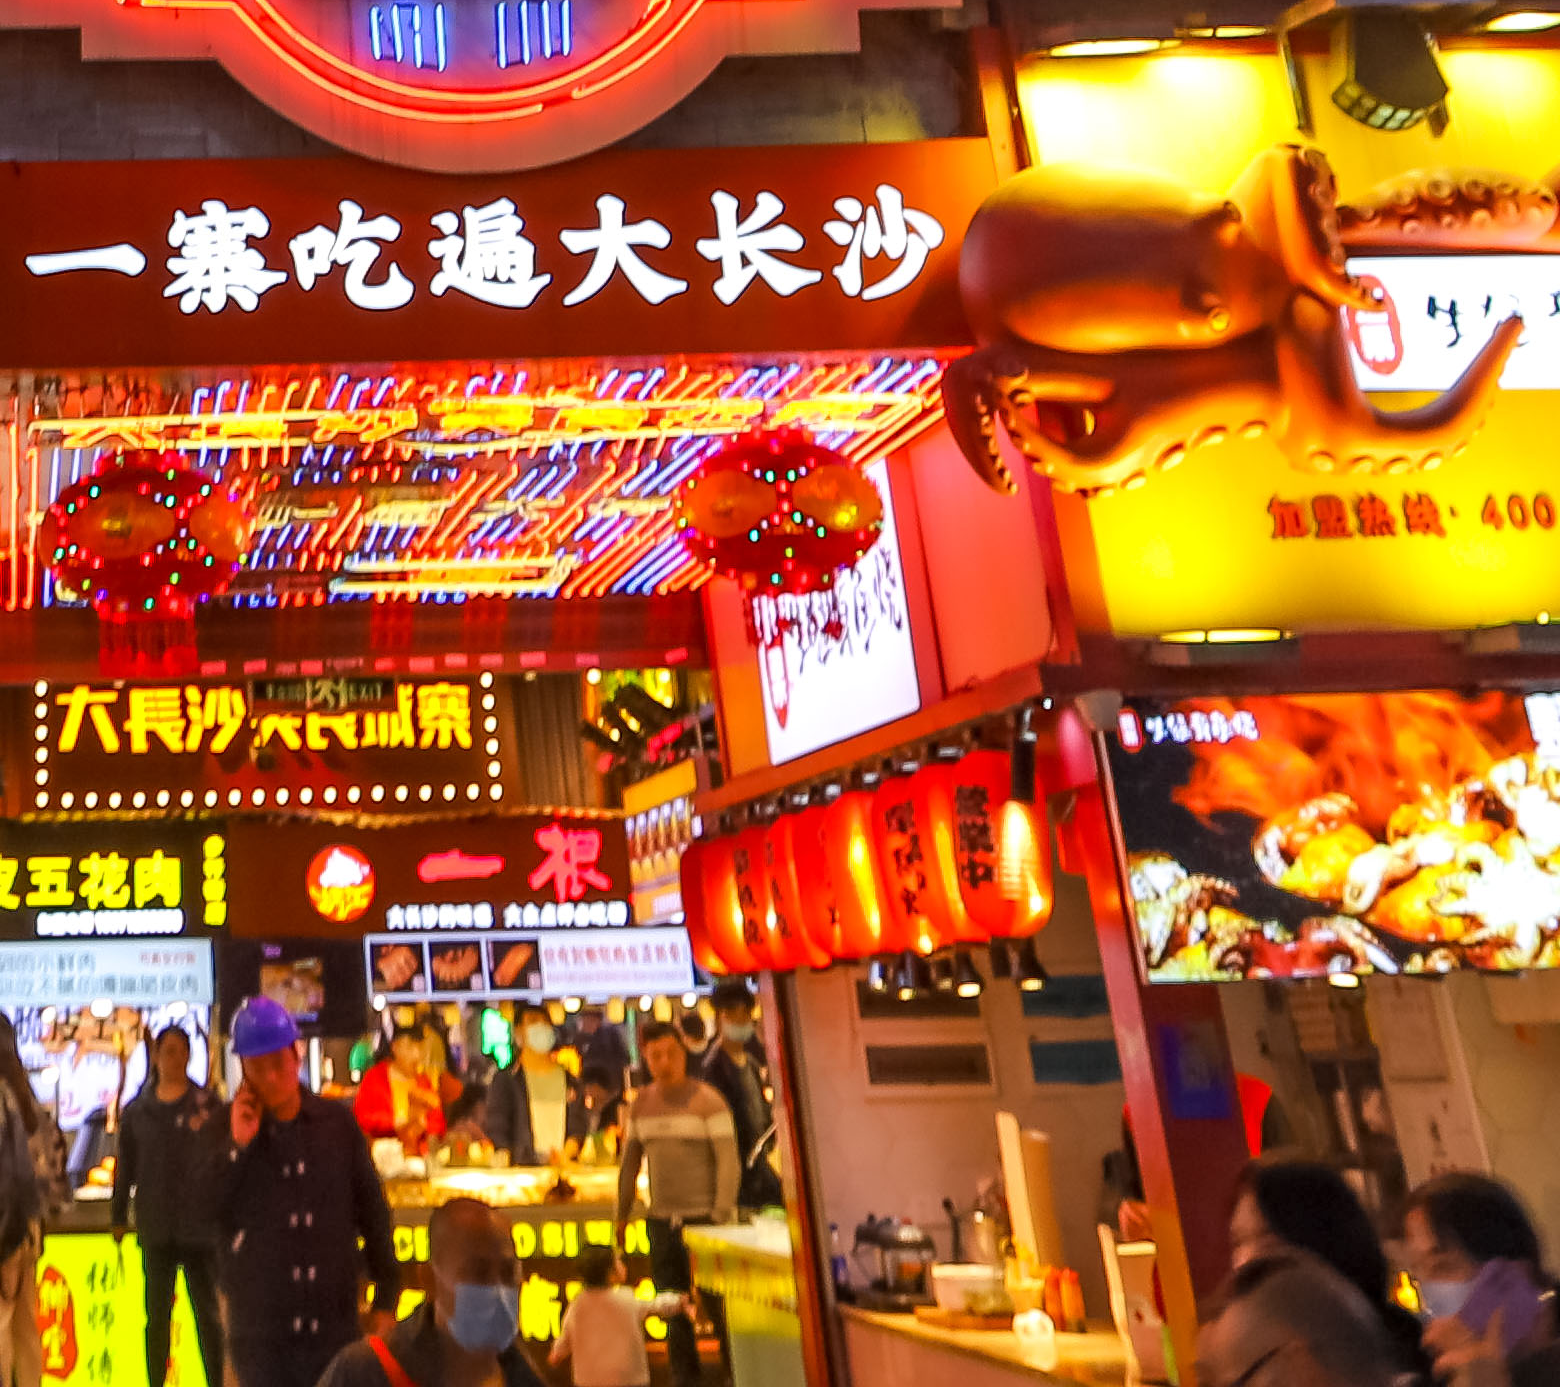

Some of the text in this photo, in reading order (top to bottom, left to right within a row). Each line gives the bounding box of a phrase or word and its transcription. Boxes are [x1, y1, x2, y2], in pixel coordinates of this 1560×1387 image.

[25, 183, 944, 313] 一寨吃遍大长沙
[1482, 493, 1555, 529] 400
